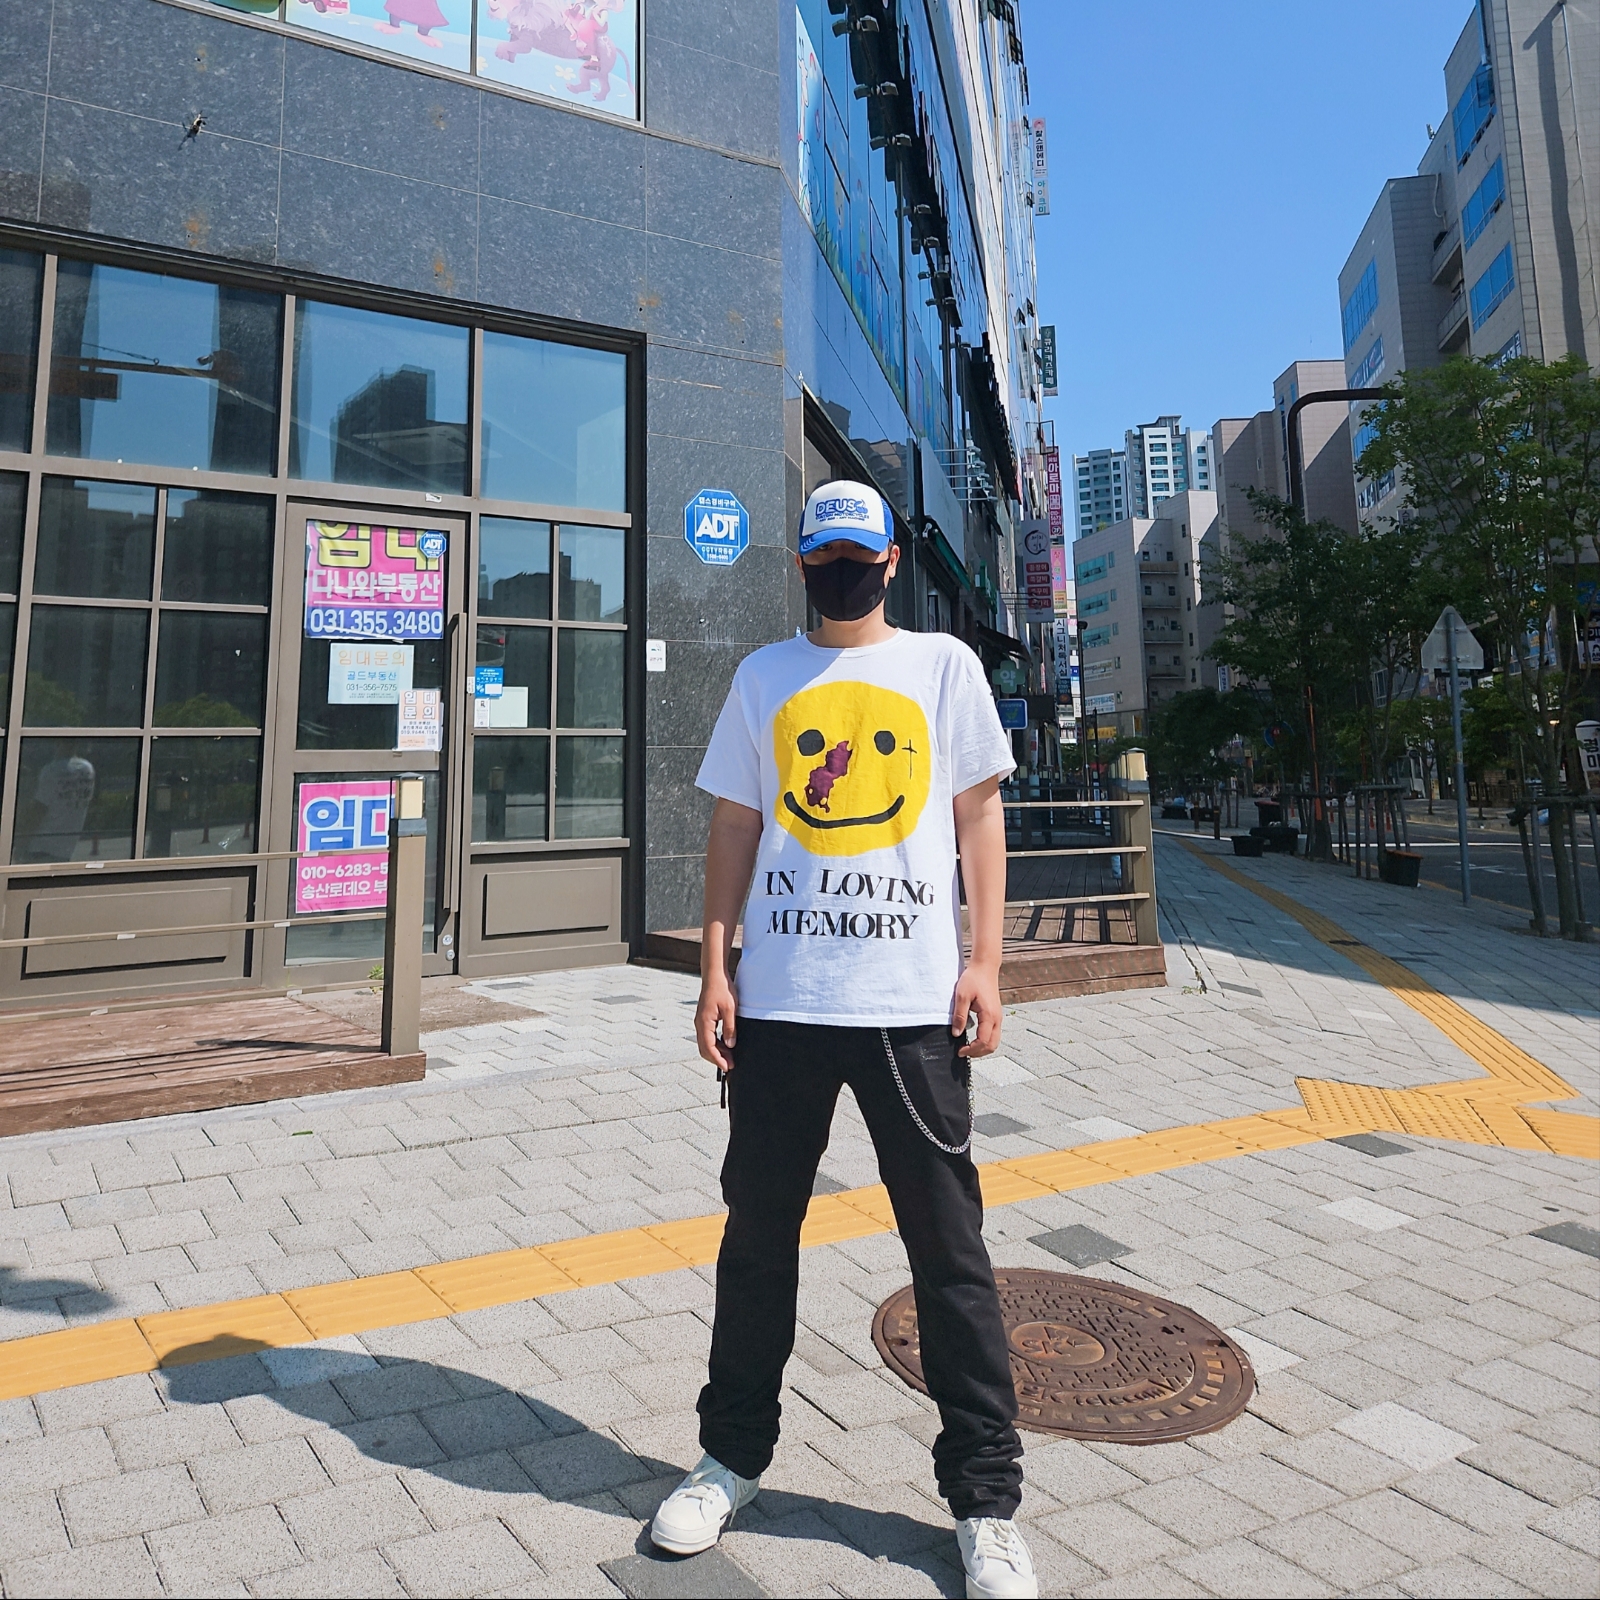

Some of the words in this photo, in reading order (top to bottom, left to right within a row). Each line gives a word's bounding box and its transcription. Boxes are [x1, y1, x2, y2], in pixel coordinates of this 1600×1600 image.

[1048, 463, 1059, 493] 아로마
[815, 498, 857, 517] DEUS
[696, 512, 739, 540] ADT
[424, 538, 443, 550] ADT
[312, 569, 441, 603] 다나와부동산
[310, 608, 443, 635] 031.355.3480
[338, 649, 406, 667] 임대문의
[1056, 619, 1068, 677] 시그니처독서실
[347, 670, 397, 681] 골드부동산
[1000, 669, 1016, 687] 약
[346, 683, 397, 691] 031-356-7575
[301, 880, 371, 900] 송산로데오
[764, 870, 797, 896] IN
[816, 868, 935, 907] LOVING
[766, 909, 920, 940] MEMORY
[1073, 1388, 1166, 1406] telecom
